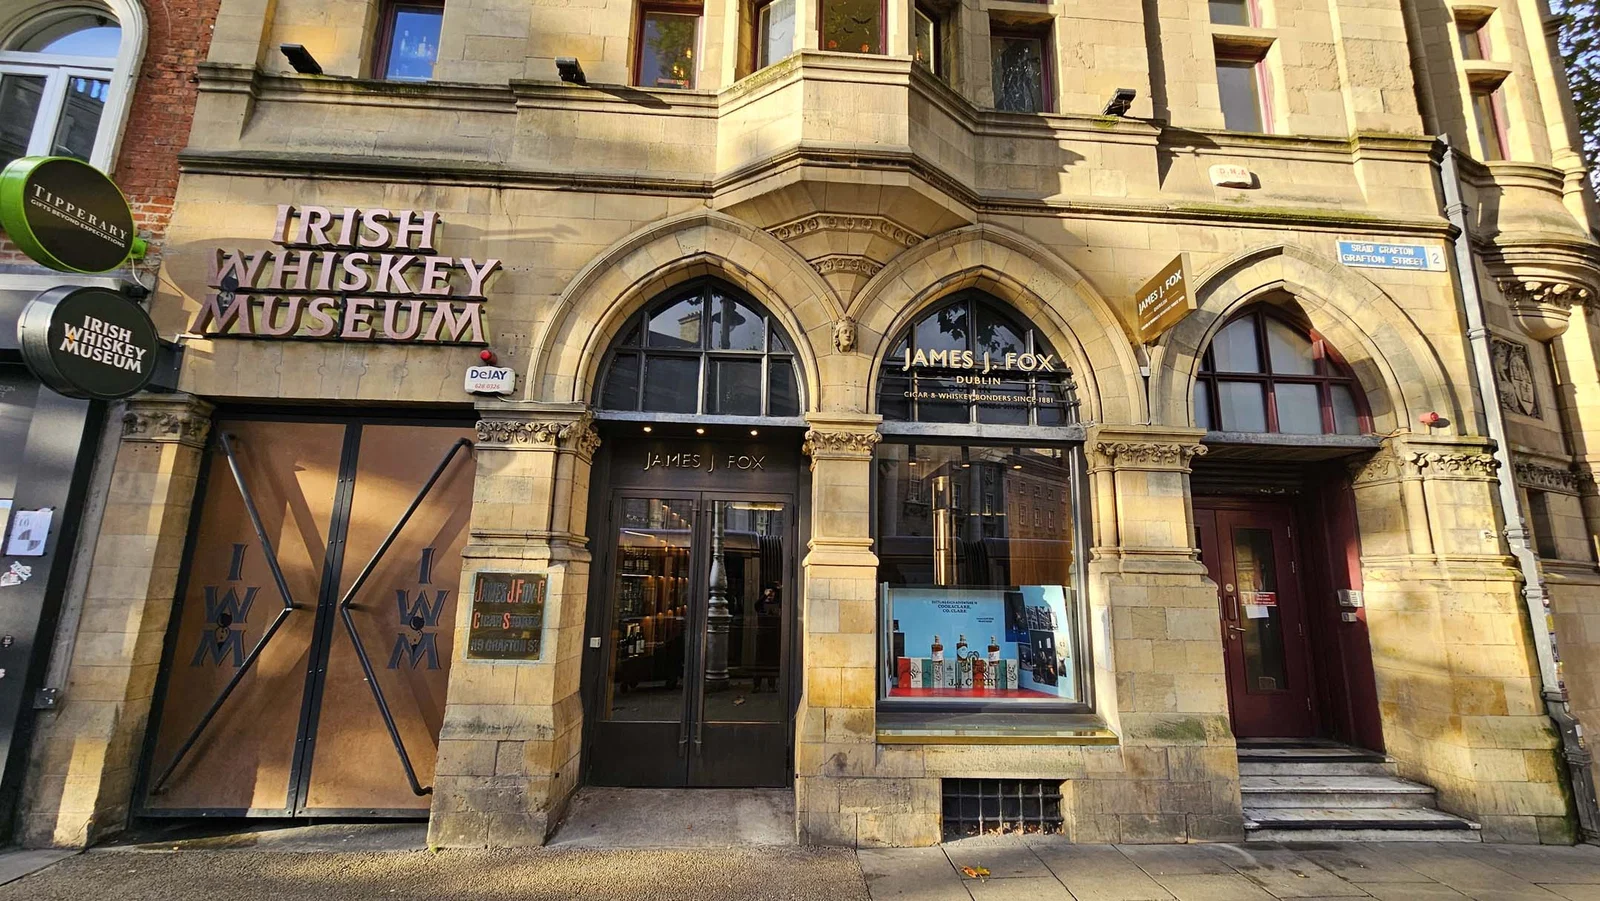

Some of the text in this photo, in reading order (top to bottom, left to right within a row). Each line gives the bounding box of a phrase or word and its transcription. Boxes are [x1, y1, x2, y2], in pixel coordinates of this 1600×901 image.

[30, 199, 125, 248] GIFTS BEYOND EXPECTATIONS
[33, 183, 128, 240] TIPPERARY
[271, 204, 440, 250] IRISH
[1342, 253, 1424, 266] GRAFTON STREET
[1378, 246, 1414, 256] GRAFTON
[1431, 252, 1440, 265] 2
[207, 248, 501, 298] WHISKEY
[1138, 289, 1159, 317] JAMES
[1165, 269, 1182, 290] FOX
[83, 315, 132, 343] IRISH
[189, 292, 486, 344] MUSEUM
[59, 338, 142, 374] MUSEUM
[64, 322, 147, 360] WHISKEY
[902, 347, 1055, 375] JAMES J. FOX
[903, 391, 929, 399] CIGAR
[938, 392, 973, 402] WHISKEY
[975, 394, 1012, 403] BONDERS
[1013, 396, 1037, 405] SINCE
[1038, 396, 1054, 404] 1881
[956, 375, 1001, 386] DUBLIN
[643, 451, 766, 473] JAMES J FOX
[204, 586, 261, 624] W
[396, 590, 450, 627] W
[190, 630, 249, 667] M
[387, 633, 442, 670] M
[485, 639, 526, 652] GRAFTON
